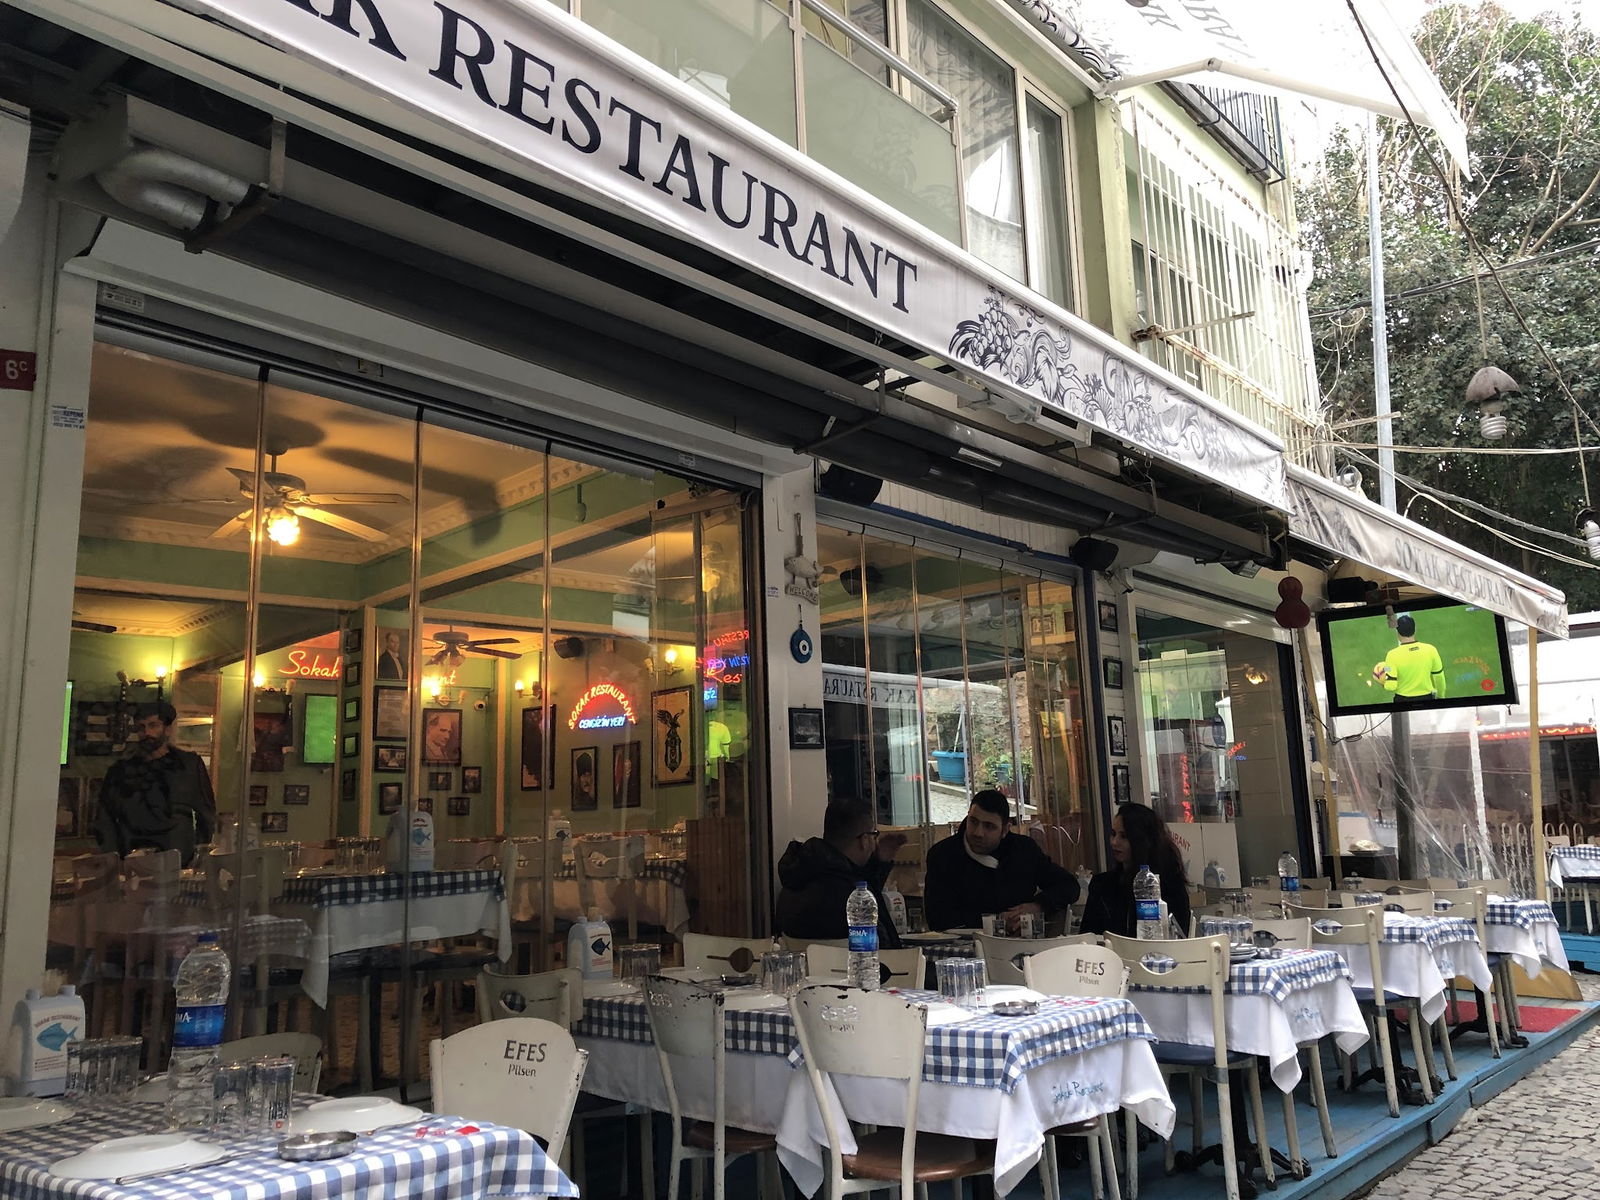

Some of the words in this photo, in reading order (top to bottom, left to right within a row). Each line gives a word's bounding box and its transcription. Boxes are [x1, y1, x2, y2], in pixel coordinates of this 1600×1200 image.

[428, 1, 918, 315] RESTAURANT
[1394, 537, 1441, 583] SOKAK
[789, 586, 819, 602] WELCOME
[278, 650, 340, 678] Sokak
[568, 692, 590, 730] SOKAK
[590, 683, 637, 725] RESTAURANT
[1075, 958, 1105, 976] EFES
[503, 1039, 548, 1063] EFES
[507, 1063, 537, 1077] Pilsen
